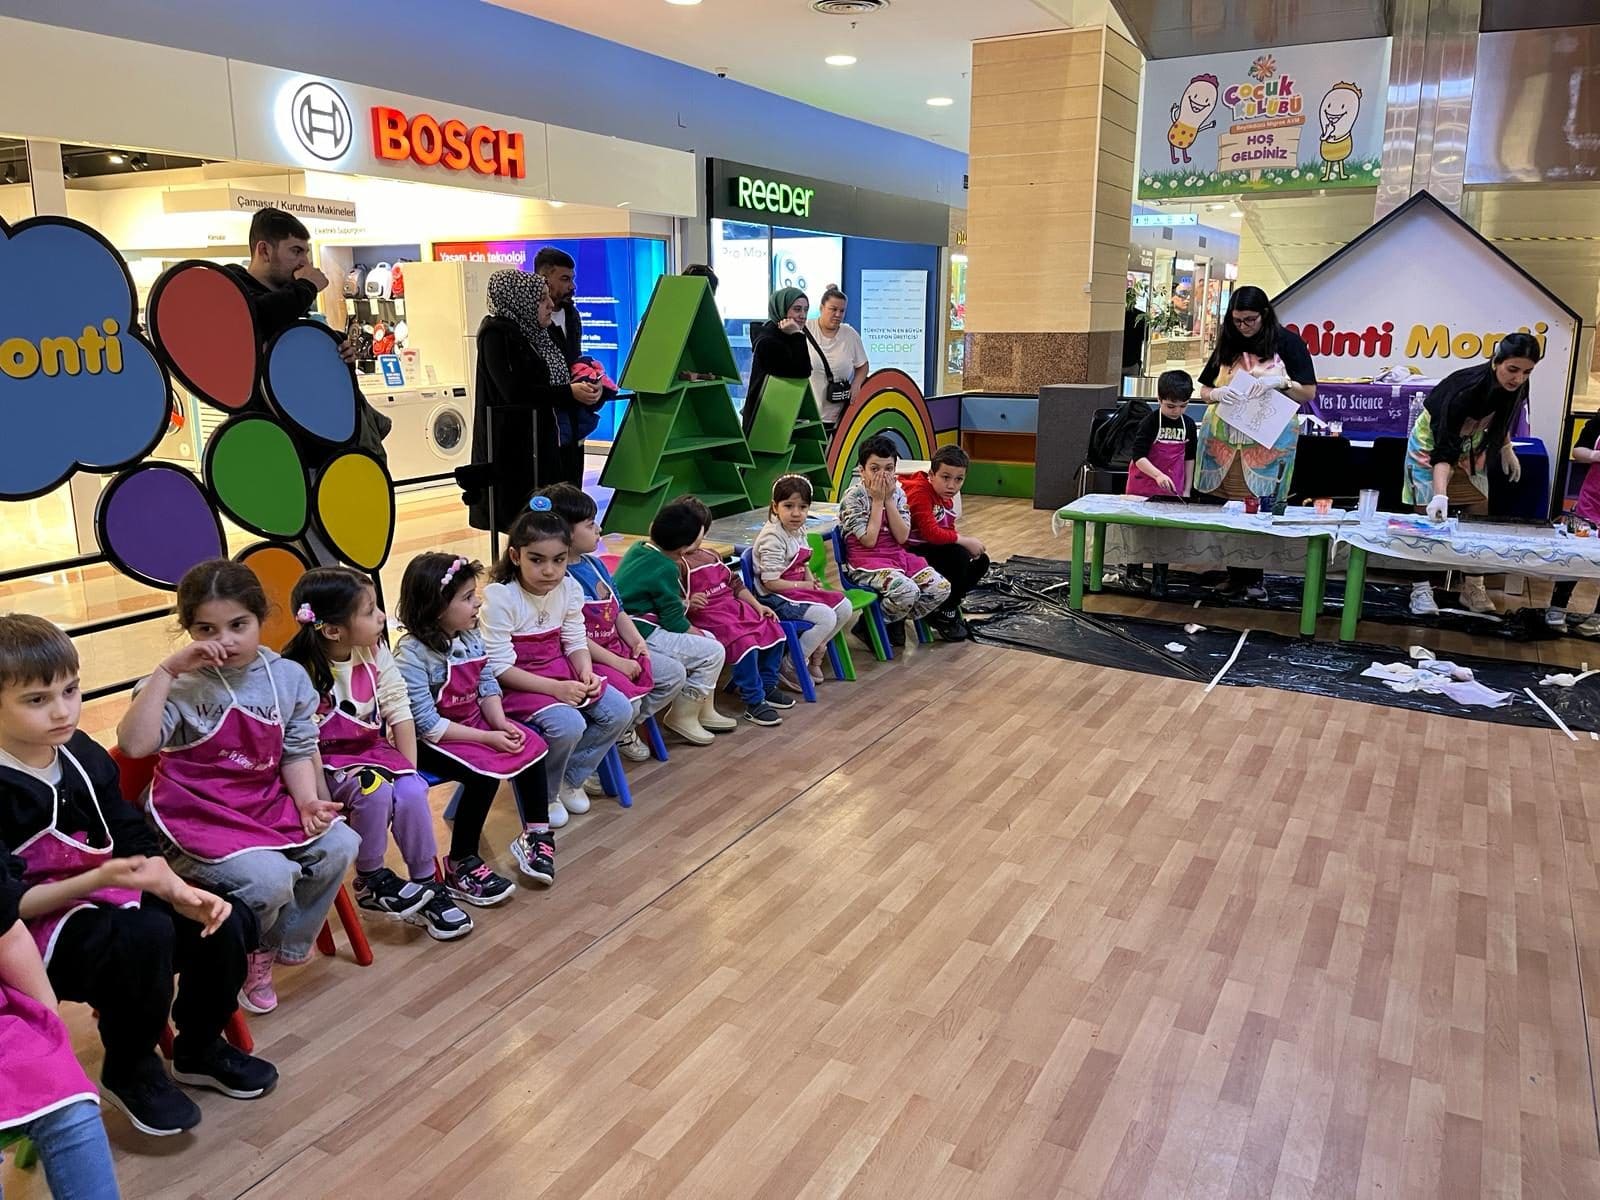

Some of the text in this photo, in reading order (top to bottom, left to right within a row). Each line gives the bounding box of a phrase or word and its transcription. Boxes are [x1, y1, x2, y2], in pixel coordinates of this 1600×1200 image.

[371, 106, 527, 179] BOSCH
[1247, 134, 1274, 146] HOŞ
[1231, 146, 1288, 162] GELDİNİZ
[281, 201, 316, 213] Kurutma
[317, 205, 356, 217] Makineleri
[487, 250, 526, 264] teknoloji
[1405, 321, 1548, 359] Moni
[1319, 394, 1383, 409] Yes To Science
